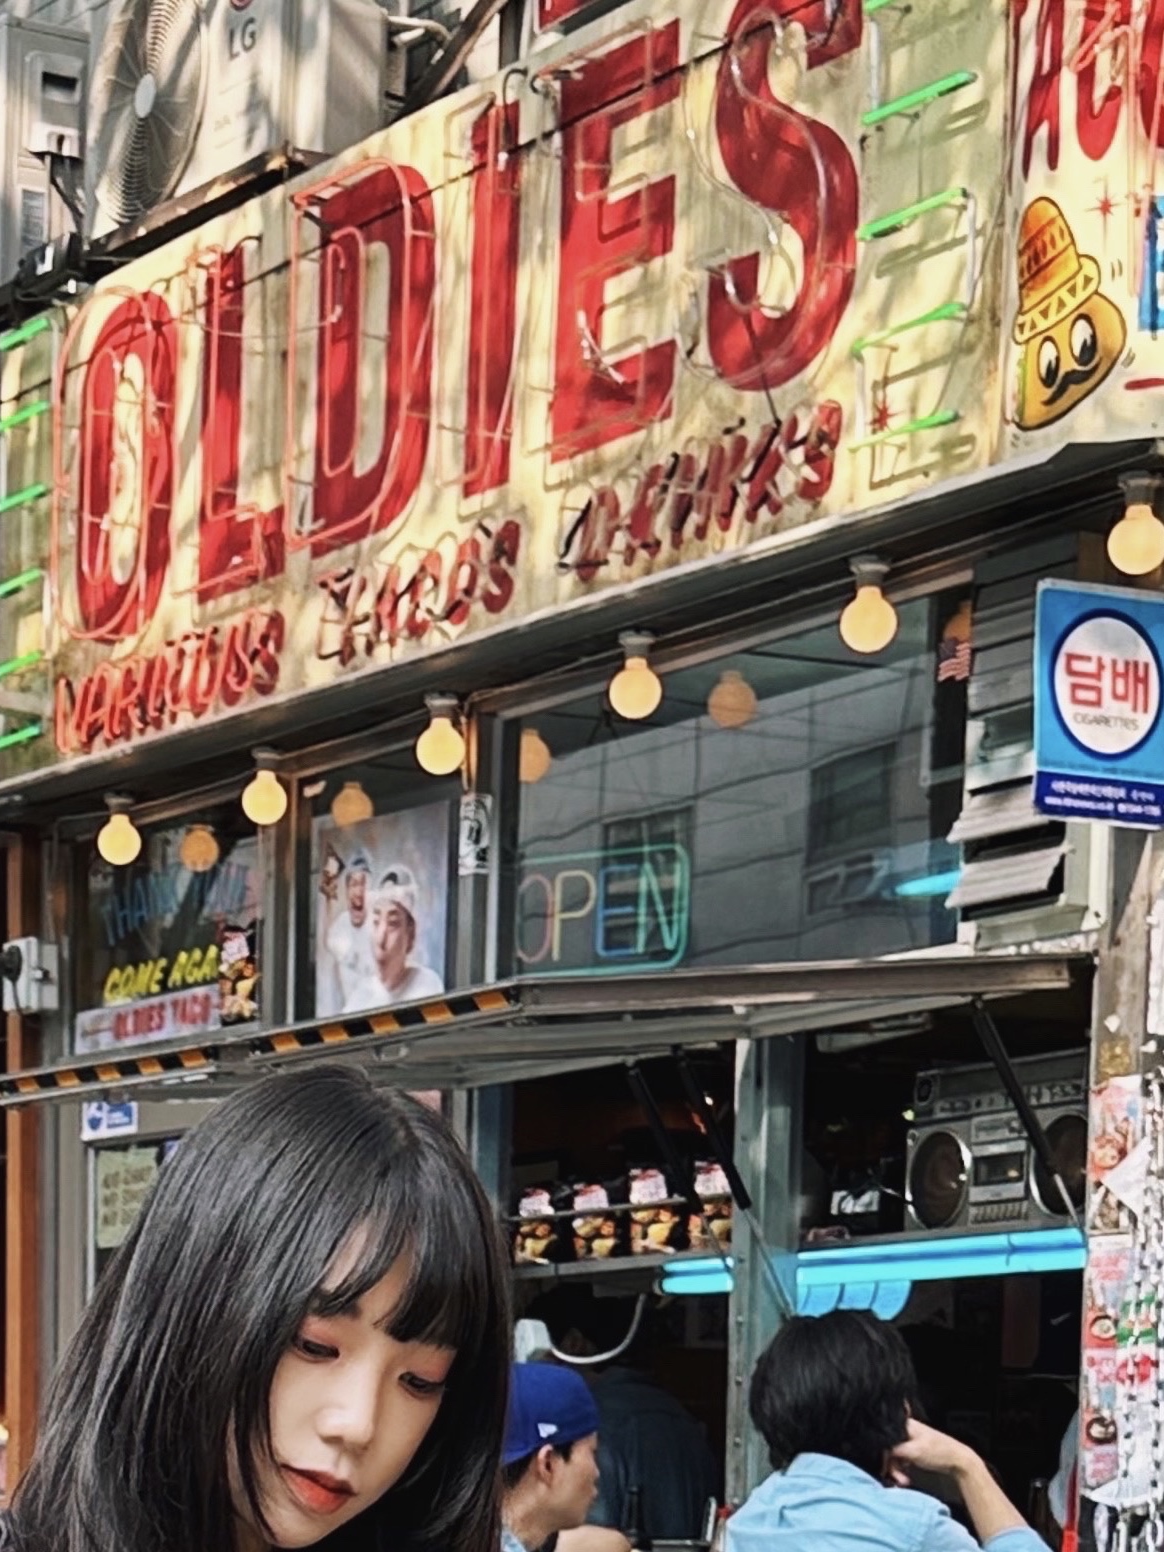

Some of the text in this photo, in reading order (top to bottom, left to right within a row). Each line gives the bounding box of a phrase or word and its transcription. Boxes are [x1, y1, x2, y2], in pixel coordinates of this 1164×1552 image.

[227, 17, 256, 60] LG
[53, 0, 864, 645] OLDIES
[1065, 652, 1150, 714] 담배
[1072, 712, 1139, 731] CIGARETTES
[517, 862, 682, 963] OPEN
[103, 957, 168, 1004] COME
